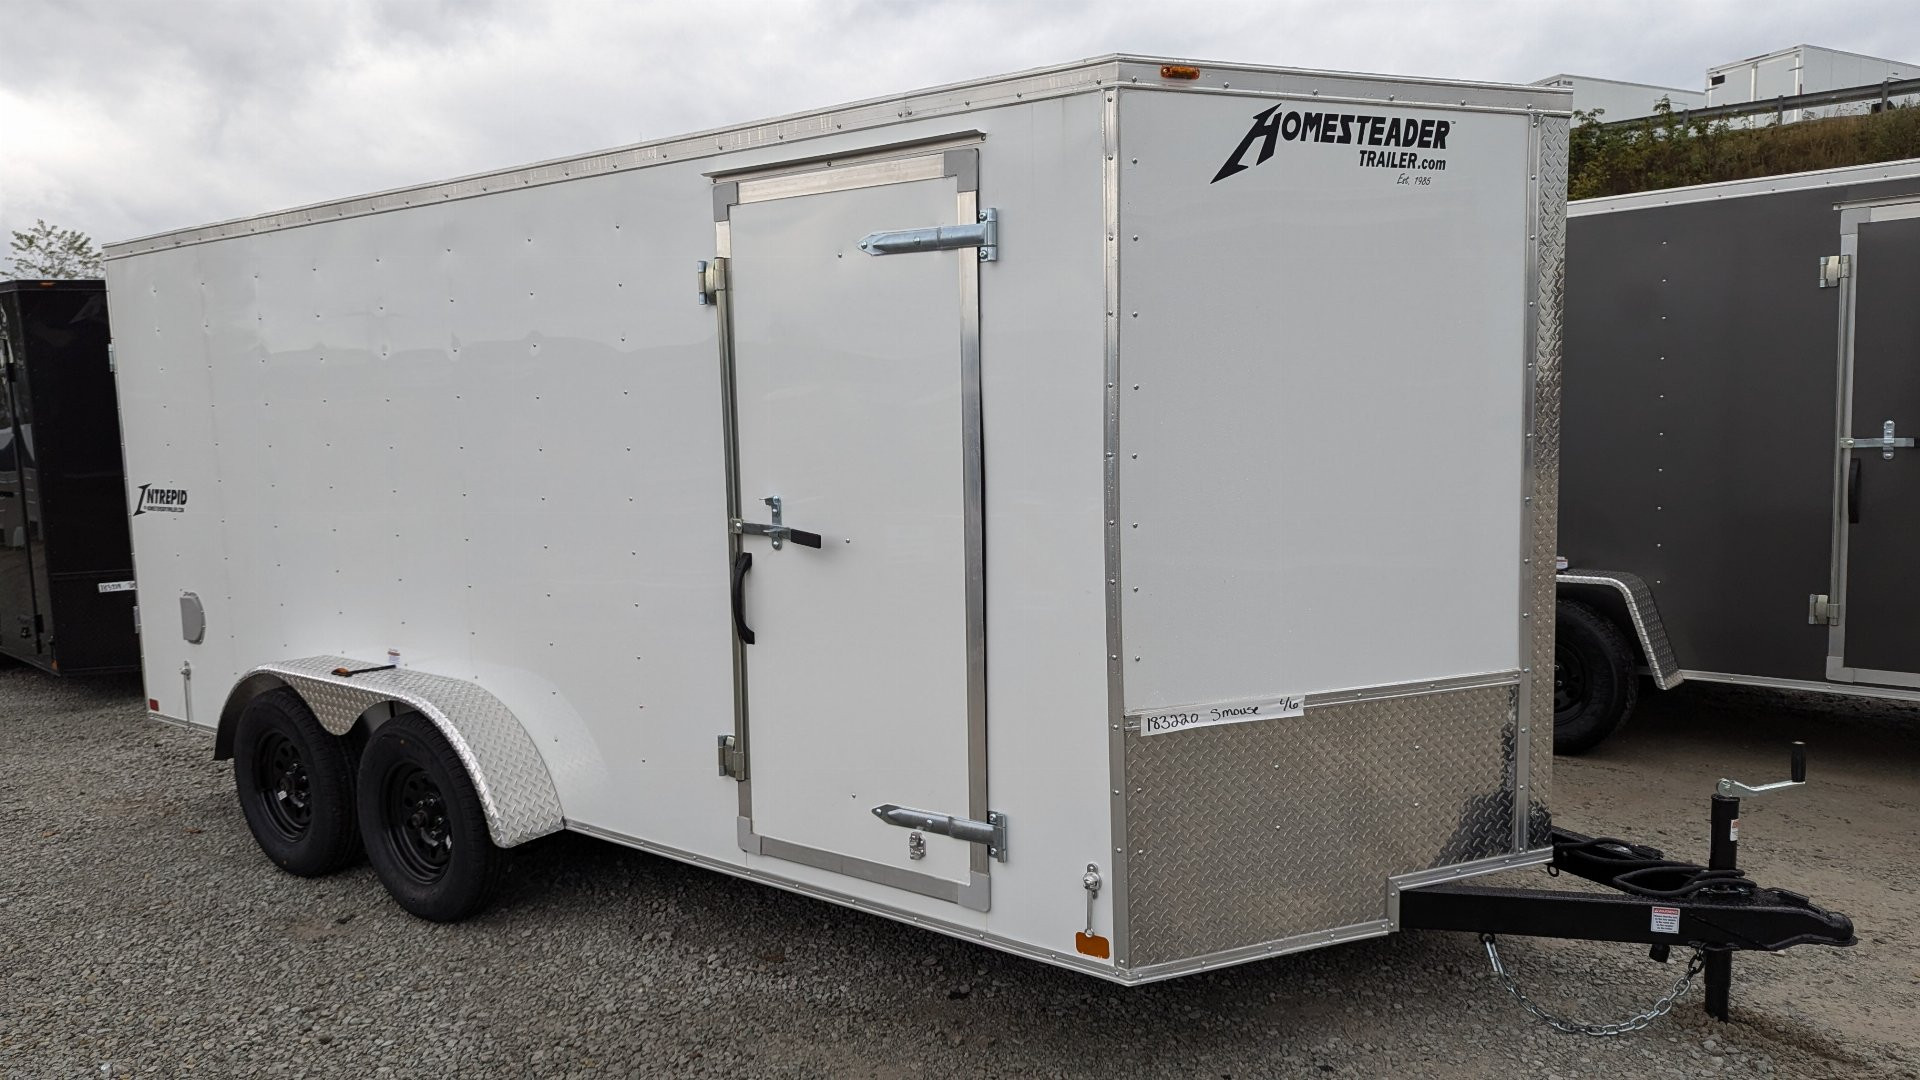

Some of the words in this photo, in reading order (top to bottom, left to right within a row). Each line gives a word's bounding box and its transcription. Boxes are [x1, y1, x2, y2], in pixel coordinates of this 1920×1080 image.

[1210, 103, 1451, 184] HOMESTEADER
[1359, 150, 1446, 170] TRAILER.com
[1414, 176, 1432, 186] 1985
[133, 482, 187, 516] INTREPID
[1147, 713, 1199, 732] 183220
